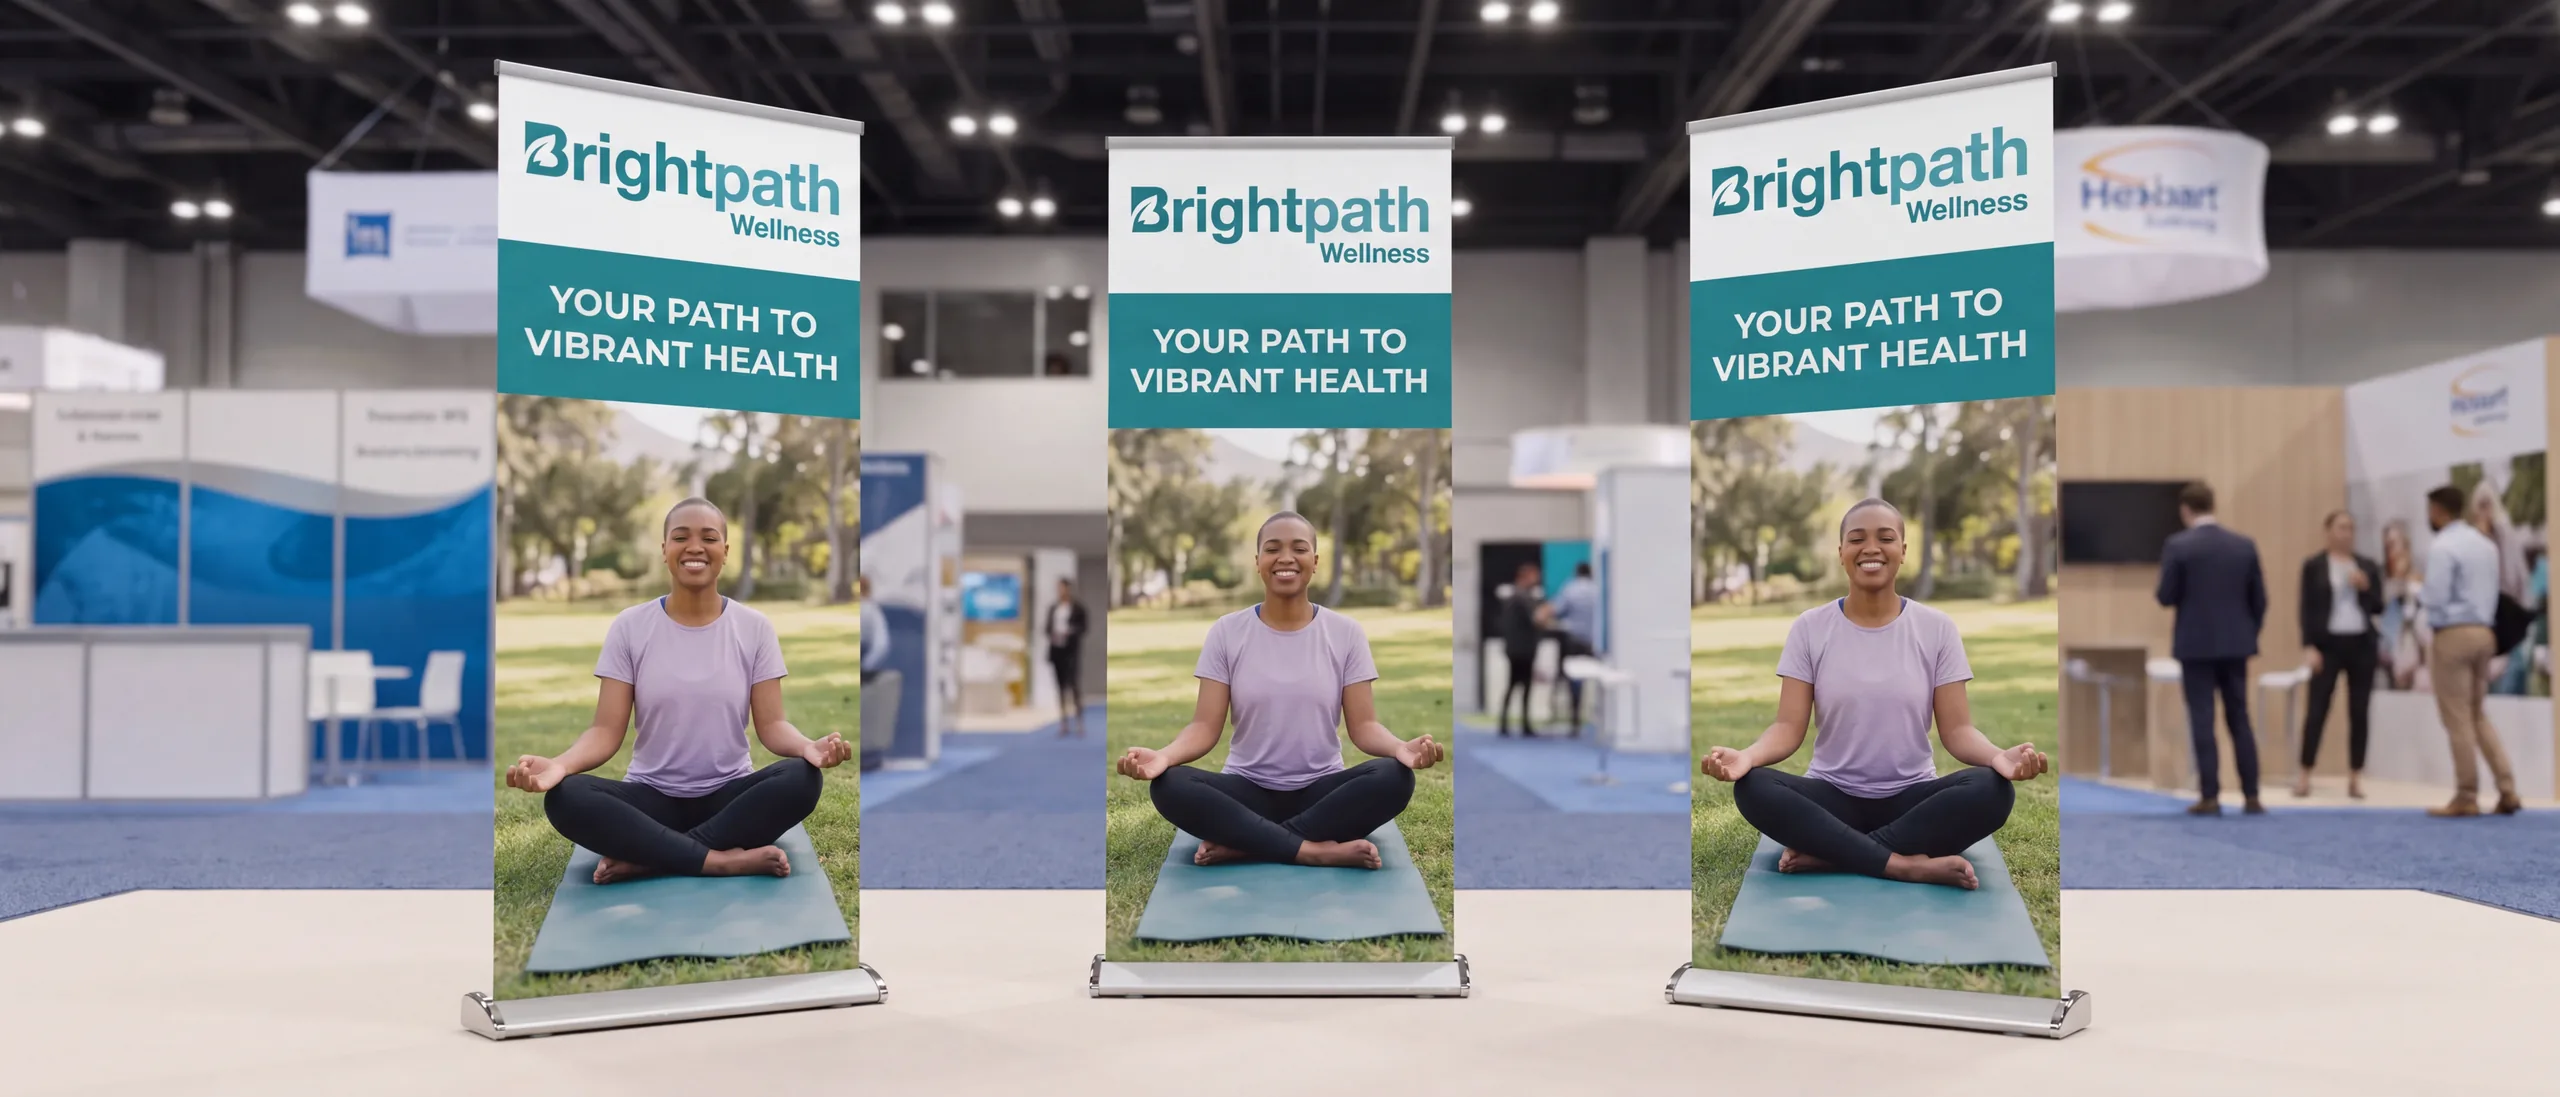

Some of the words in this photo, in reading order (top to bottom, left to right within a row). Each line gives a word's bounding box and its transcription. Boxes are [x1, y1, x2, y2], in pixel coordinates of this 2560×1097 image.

[525, 120, 840, 216] Brightpath
[1711, 125, 2029, 218] Brightpath
[730, 212, 841, 248] Wellness
[1130, 185, 1430, 245] Brightpath
[1905, 193, 2029, 224] Wellness
[1319, 242, 1430, 264] Wellness
[549, 284, 656, 323] YOUR
[668, 297, 760, 333] PATH
[770, 308, 817, 338] TO
[1734, 305, 1833, 339] YOUR
[1844, 293, 1939, 329] PATH
[1950, 288, 2003, 319] TO
[524, 327, 694, 369] VIBRANT
[704, 343, 838, 381] HEALTH
[1153, 328, 1250, 354] YOUR
[1261, 328, 1349, 354] PATH
[1359, 328, 1407, 354] TO
[1712, 343, 1870, 382] VIBRANT
[1880, 329, 2028, 369] HEALTH
[1130, 368, 1284, 393] VIBRANT
[1295, 368, 1427, 393] HEALTH
